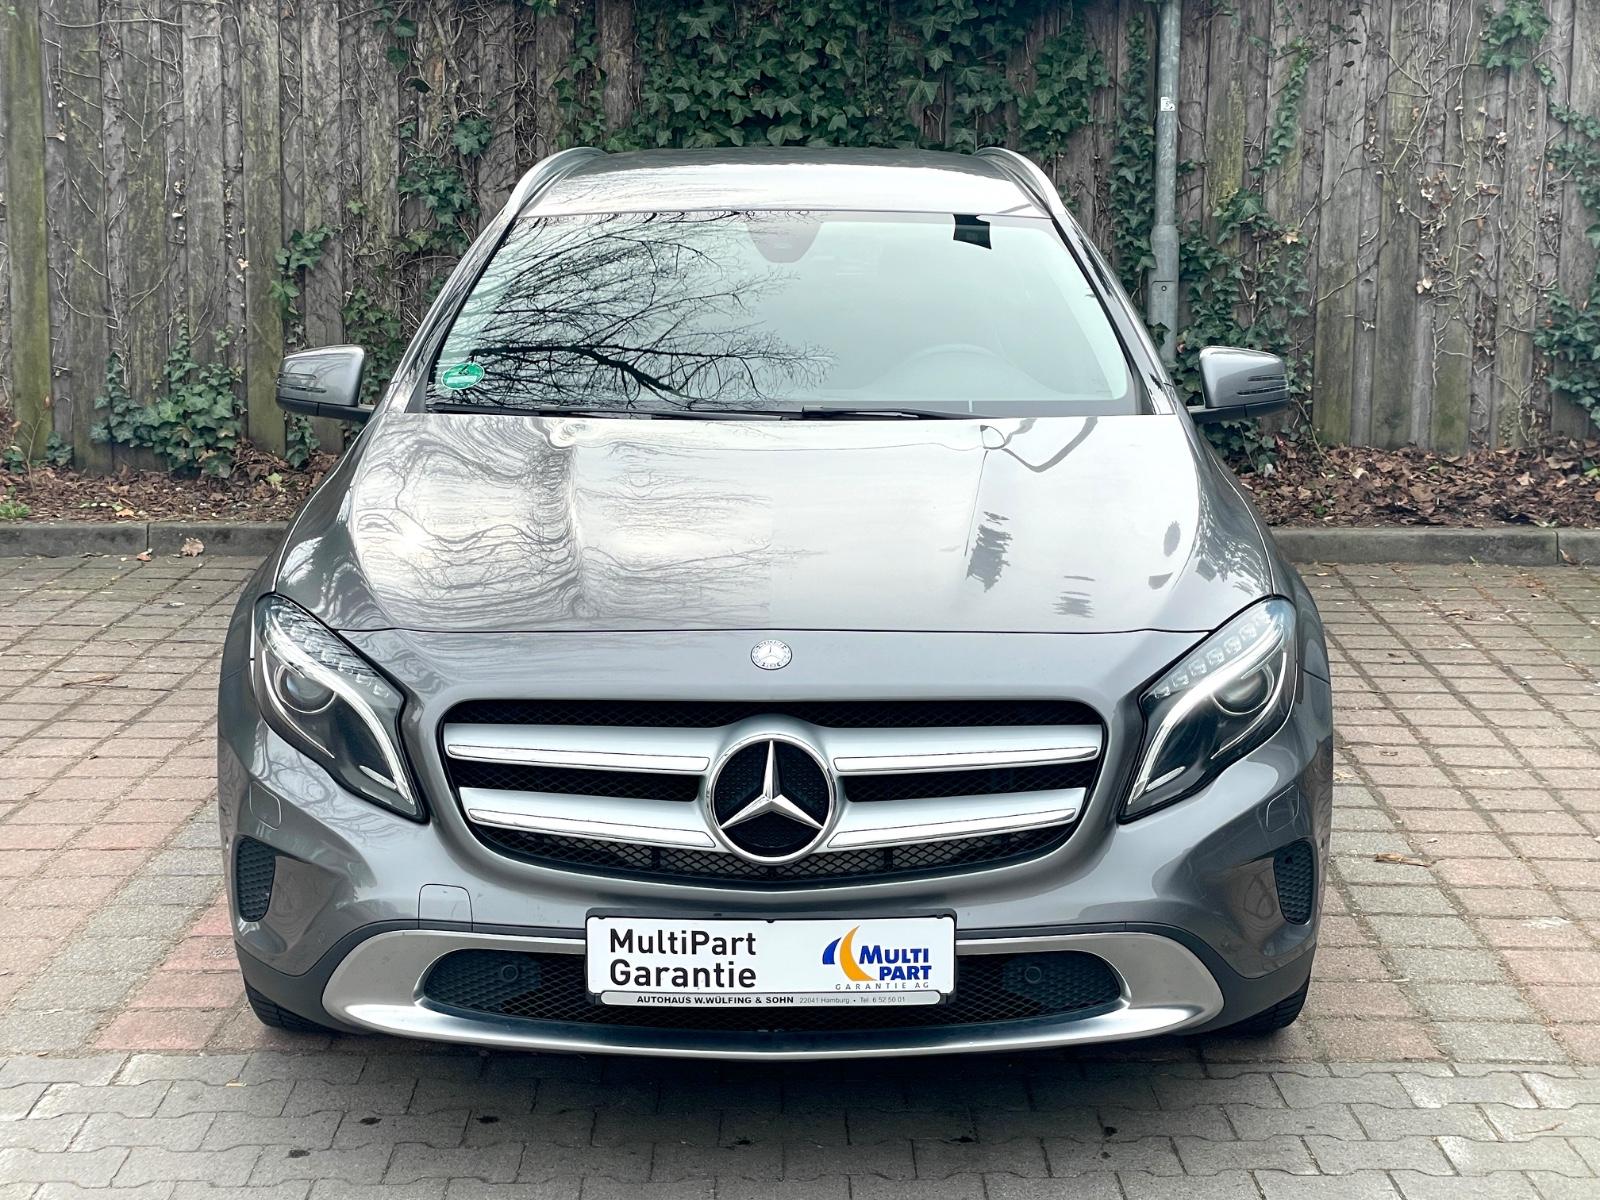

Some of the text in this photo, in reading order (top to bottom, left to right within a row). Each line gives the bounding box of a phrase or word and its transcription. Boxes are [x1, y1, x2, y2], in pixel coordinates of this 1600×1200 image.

[609, 928, 757, 956] MultiPart
[859, 945, 929, 964] MULTI
[609, 958, 757, 988] Garantie
[879, 965, 932, 980] PART
[835, 982, 907, 990] GARANTIE
[636, 995, 692, 1004] AUTOHAUS
[755, 996, 762, 1004] &
[765, 996, 794, 1004] SOHN
[820, 997, 850, 1005] Hamburg
